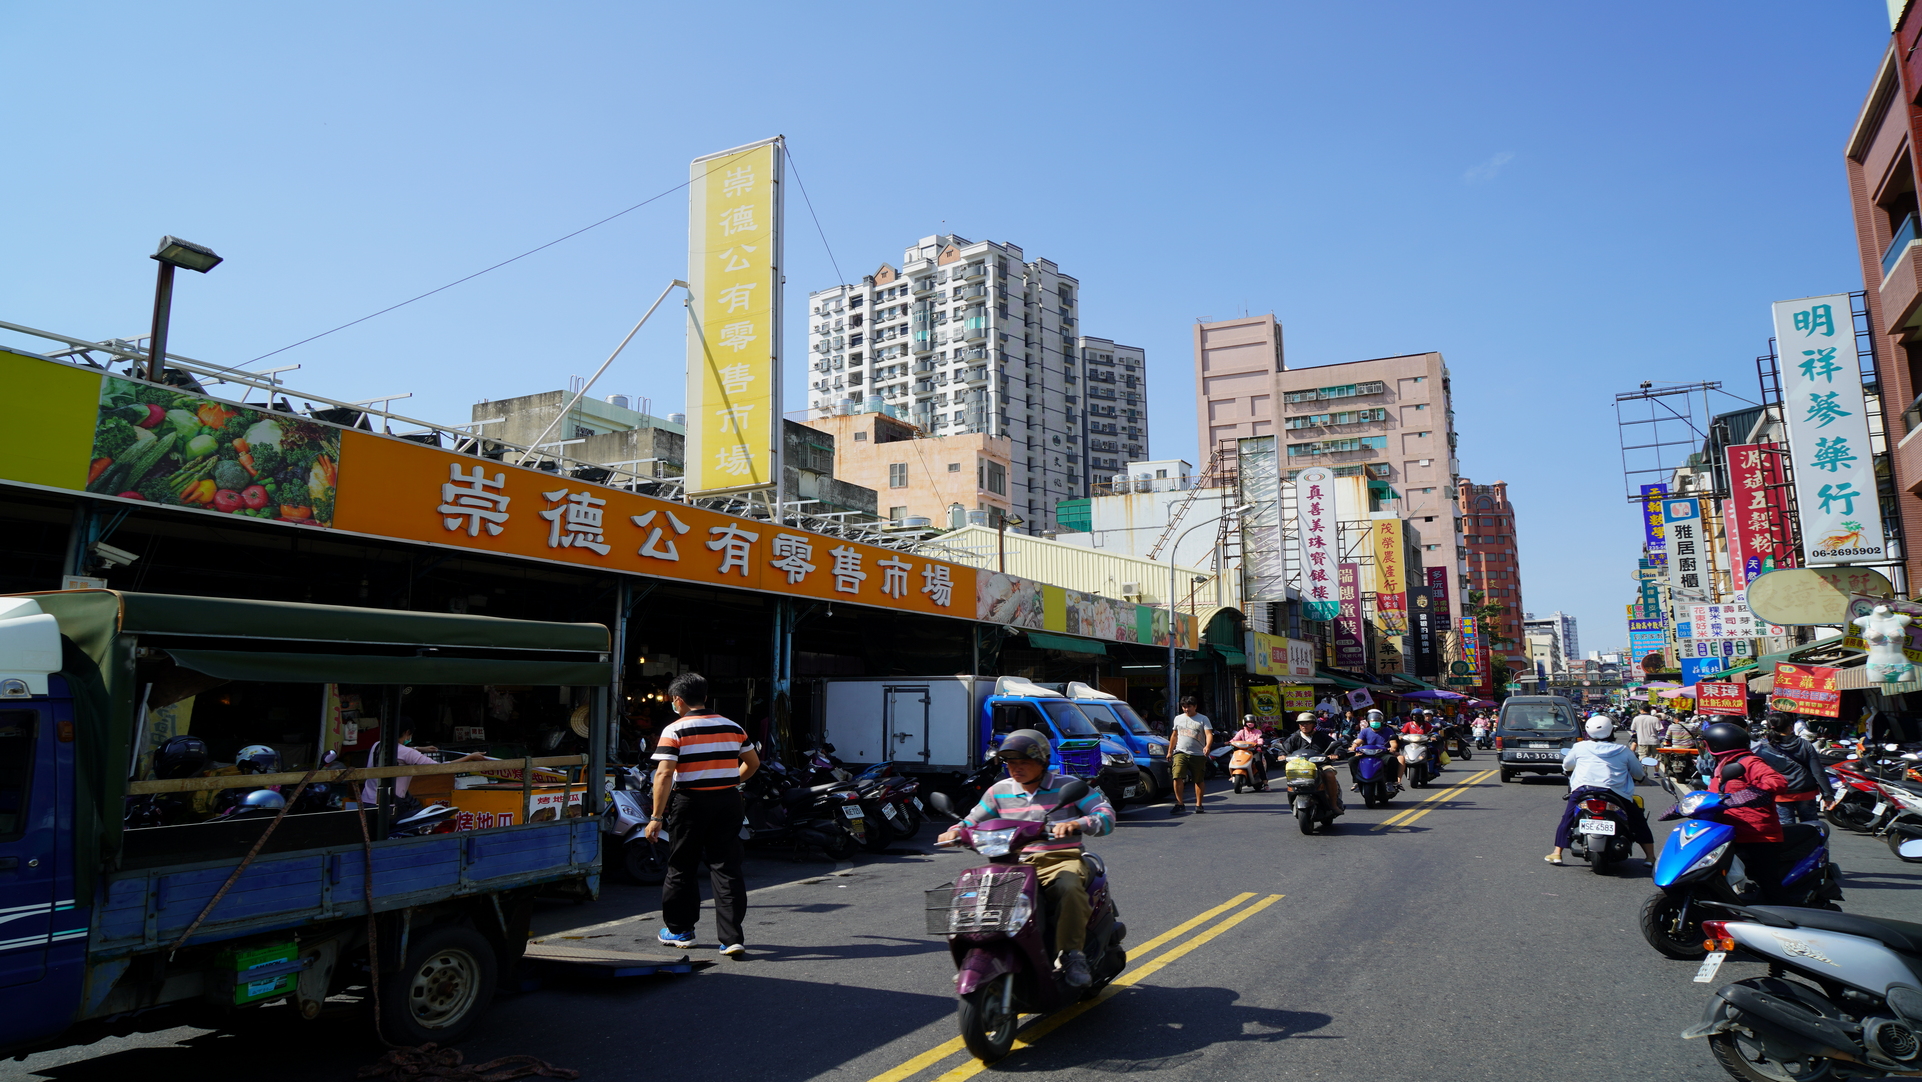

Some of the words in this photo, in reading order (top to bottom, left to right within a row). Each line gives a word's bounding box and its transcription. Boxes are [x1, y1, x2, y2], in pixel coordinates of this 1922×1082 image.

[715, 165, 758, 477] 崇德公有零售市場
[1793, 303, 1861, 516] 明祥蔘藥行
[437, 463, 955, 608] 崇德公有零售市場
[1306, 484, 1330, 600] 真善美珠寶銀樓
[1380, 522, 1398, 592] 茂榮農產行
[1674, 524, 1700, 588] 雅居廚櫃
[1812, 546, 1882, 558] 06-2695902
[1308, 602, 1335, 611] GIA
[1694, 606, 1708, 638] 花東好米
[1723, 605, 1738, 637] 壽司米
[1285, 690, 1313, 698] 大黃蜂
[1285, 700, 1314, 708] 爆米花
[1702, 684, 1740, 698] 東璋
[1516, 752, 1560, 760] BA-3029
[456, 811, 515, 832] 烤地瓜
